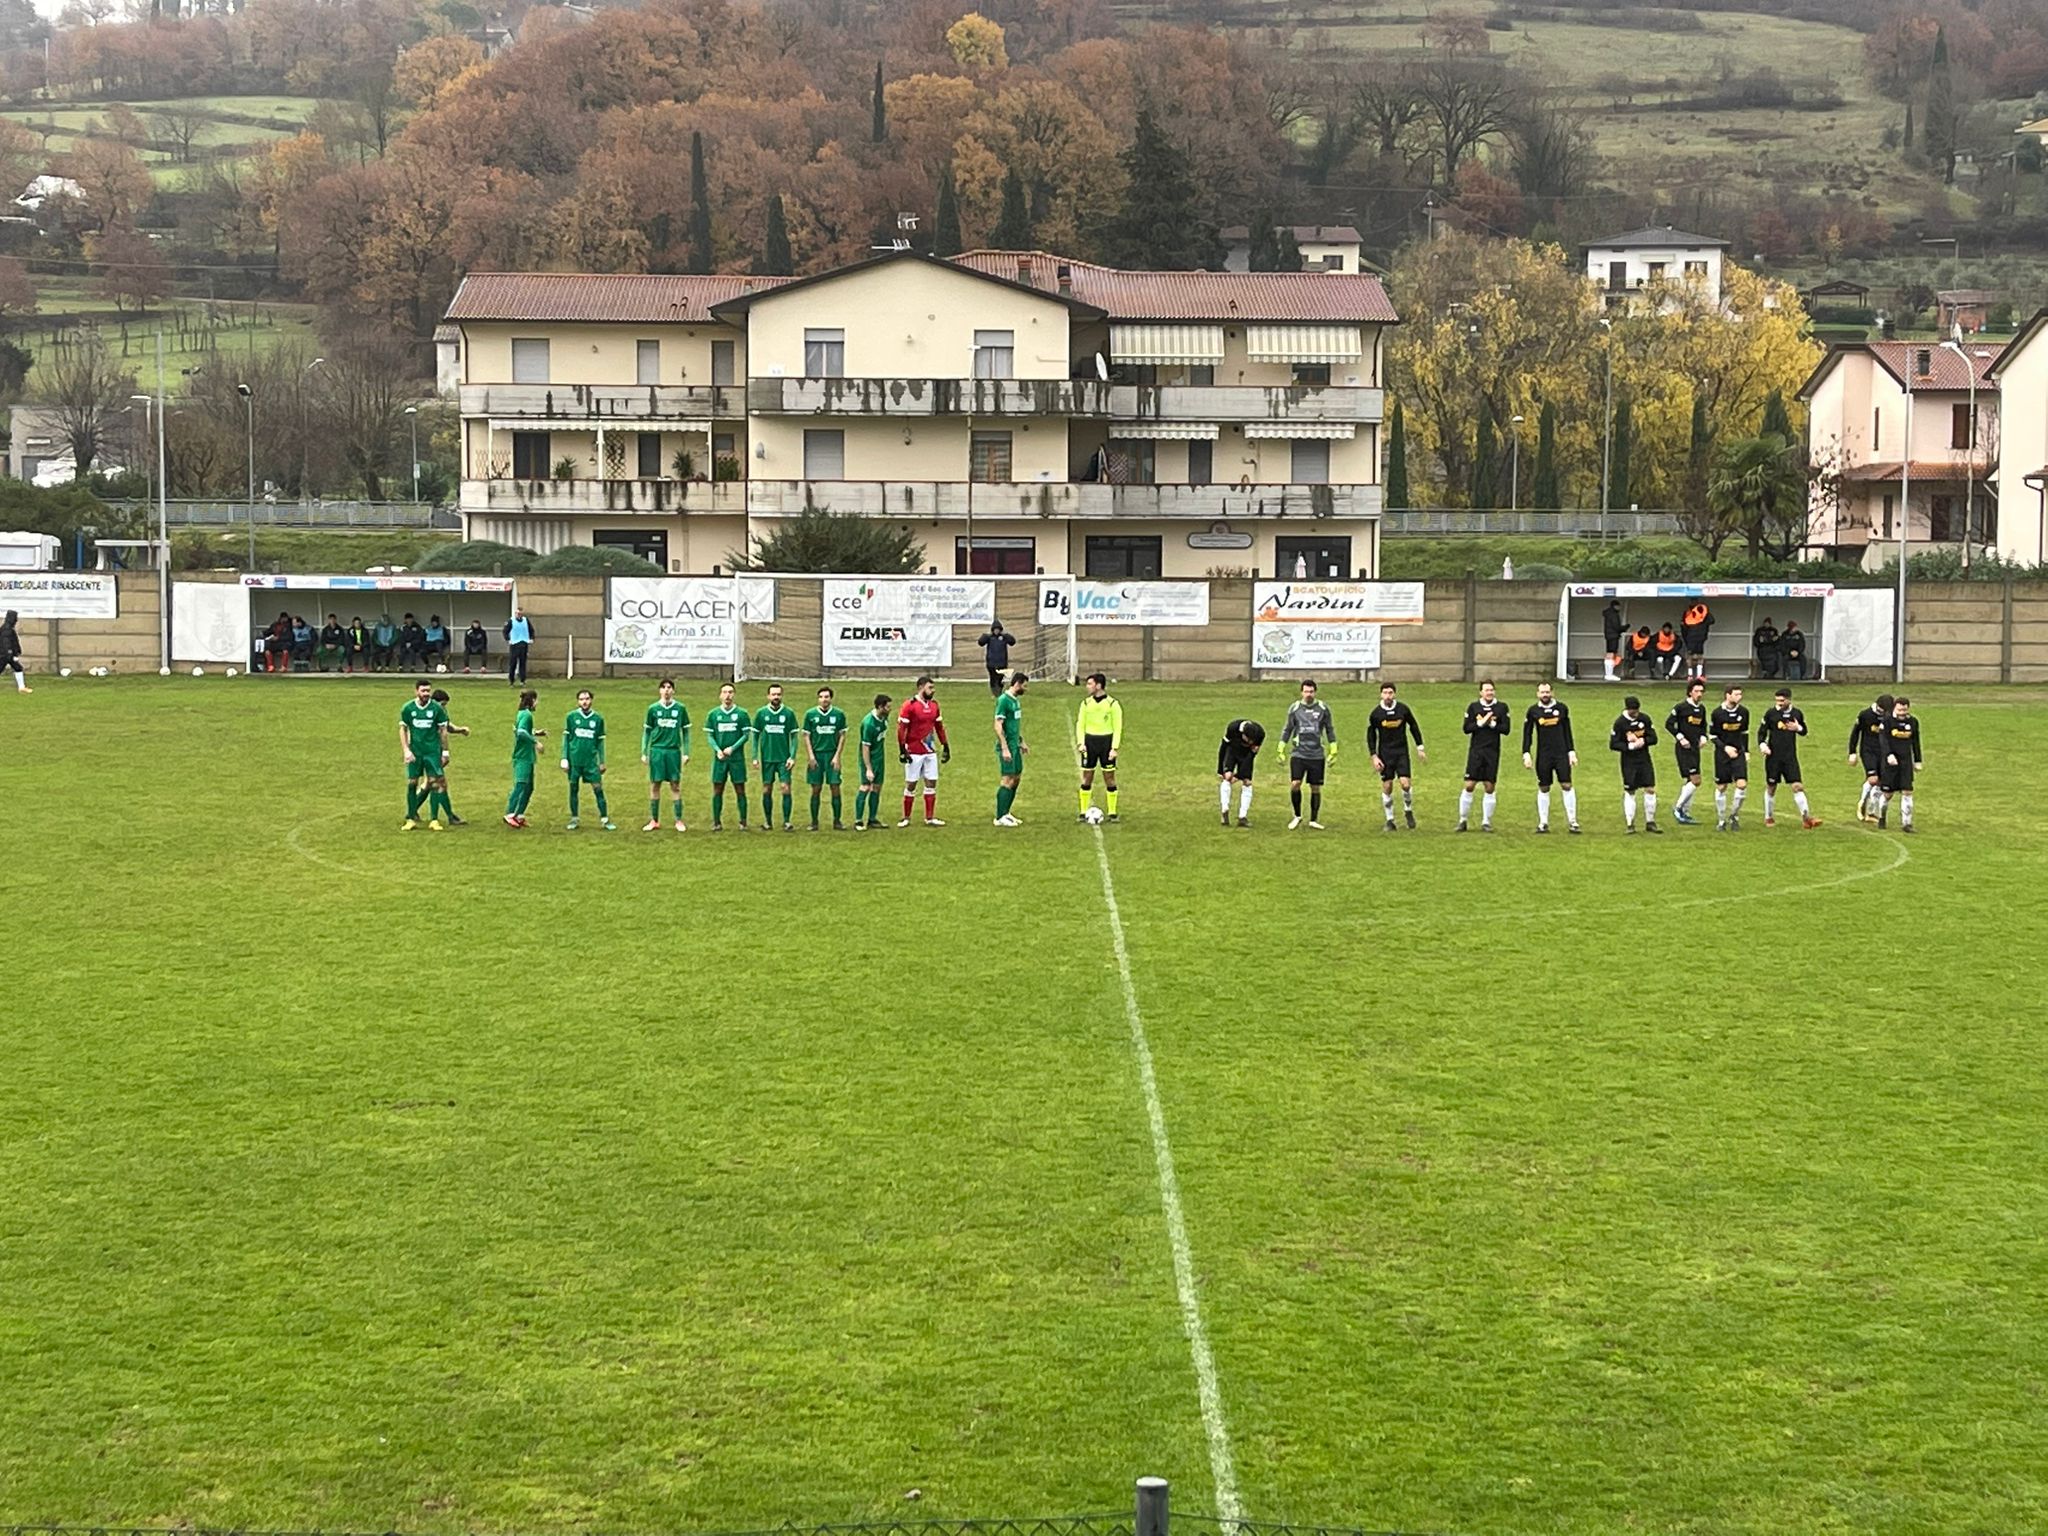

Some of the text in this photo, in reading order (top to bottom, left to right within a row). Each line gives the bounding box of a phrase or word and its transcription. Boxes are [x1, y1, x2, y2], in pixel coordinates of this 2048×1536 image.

[51, 580, 102, 591] RINASCENTE
[832, 597, 863, 609] cce
[1044, 590, 1071, 615] By
[1076, 589, 1121, 609] Vac
[1257, 585, 1366, 611] Nardini
[620, 599, 749, 619] COLACEM
[659, 624, 726, 637] Krima S.r.l.
[1306, 629, 1343, 642] Krima
